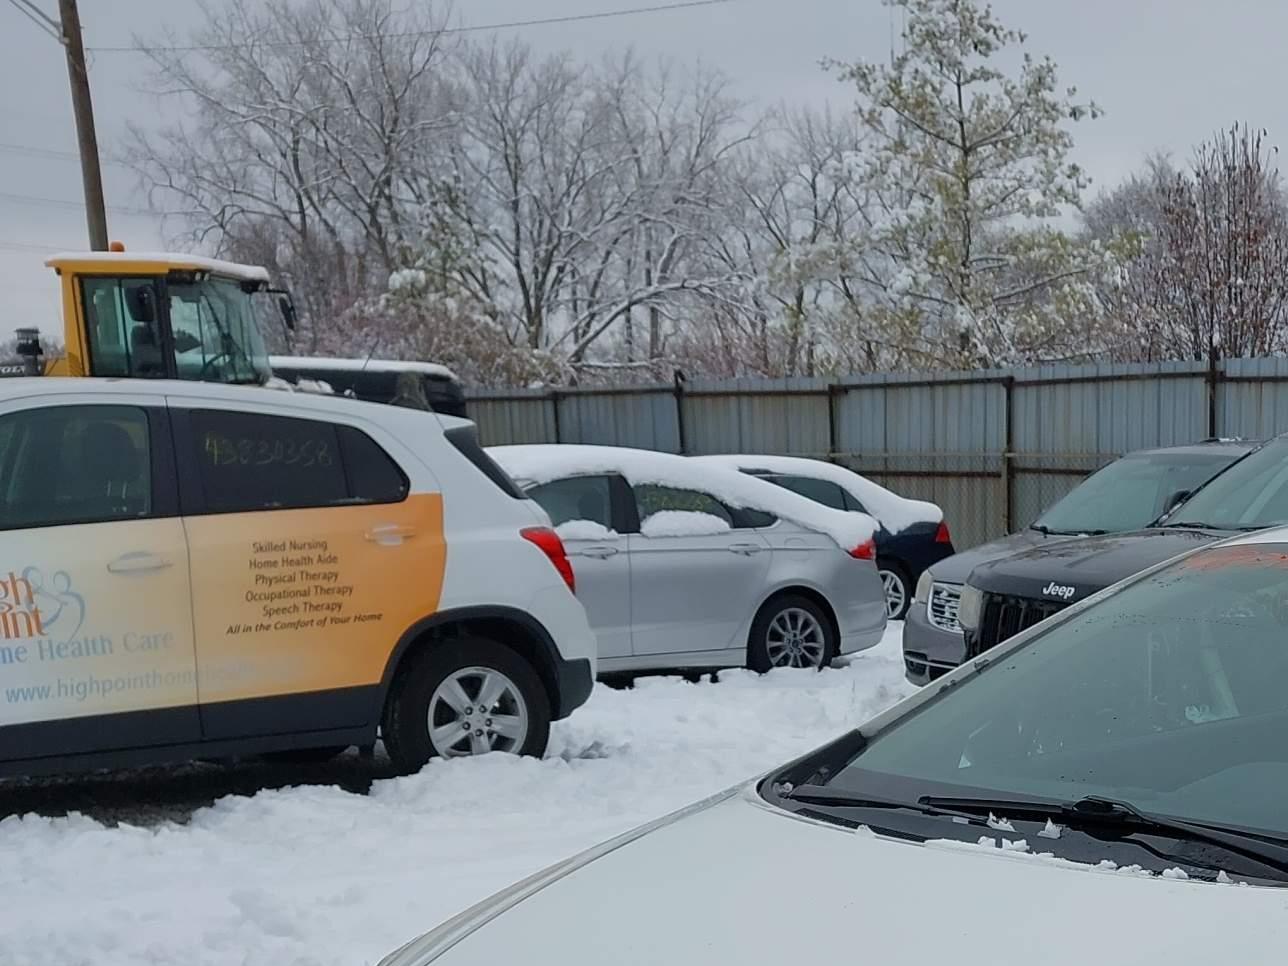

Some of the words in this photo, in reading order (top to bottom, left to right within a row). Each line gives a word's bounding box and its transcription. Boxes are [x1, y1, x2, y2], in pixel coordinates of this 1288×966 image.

[252, 541, 286, 553] Skilled
[289, 541, 328, 552] Nursing
[249, 558, 279, 569] Home
[281, 556, 313, 567] Health
[316, 554, 338, 565] Aide
[255, 572, 296, 587] Physical
[300, 570, 338, 583] Therapy
[245, 586, 311, 603] Occupational
[314, 584, 353, 597] Therapy
[1043, 582, 1075, 599] Jeep
[263, 603, 299, 617] Speech
[303, 601, 343, 613] Therapy
[226, 624, 240, 634] All
[242, 623, 252, 632] in
[255, 622, 271, 632] the
[274, 618, 315, 631] Comfort
[316, 616, 327, 627] of
[329, 616, 350, 625] Your
[354, 613, 383, 623] Home
[38, 635, 113, 662] Health
[123, 631, 174, 653] Care
